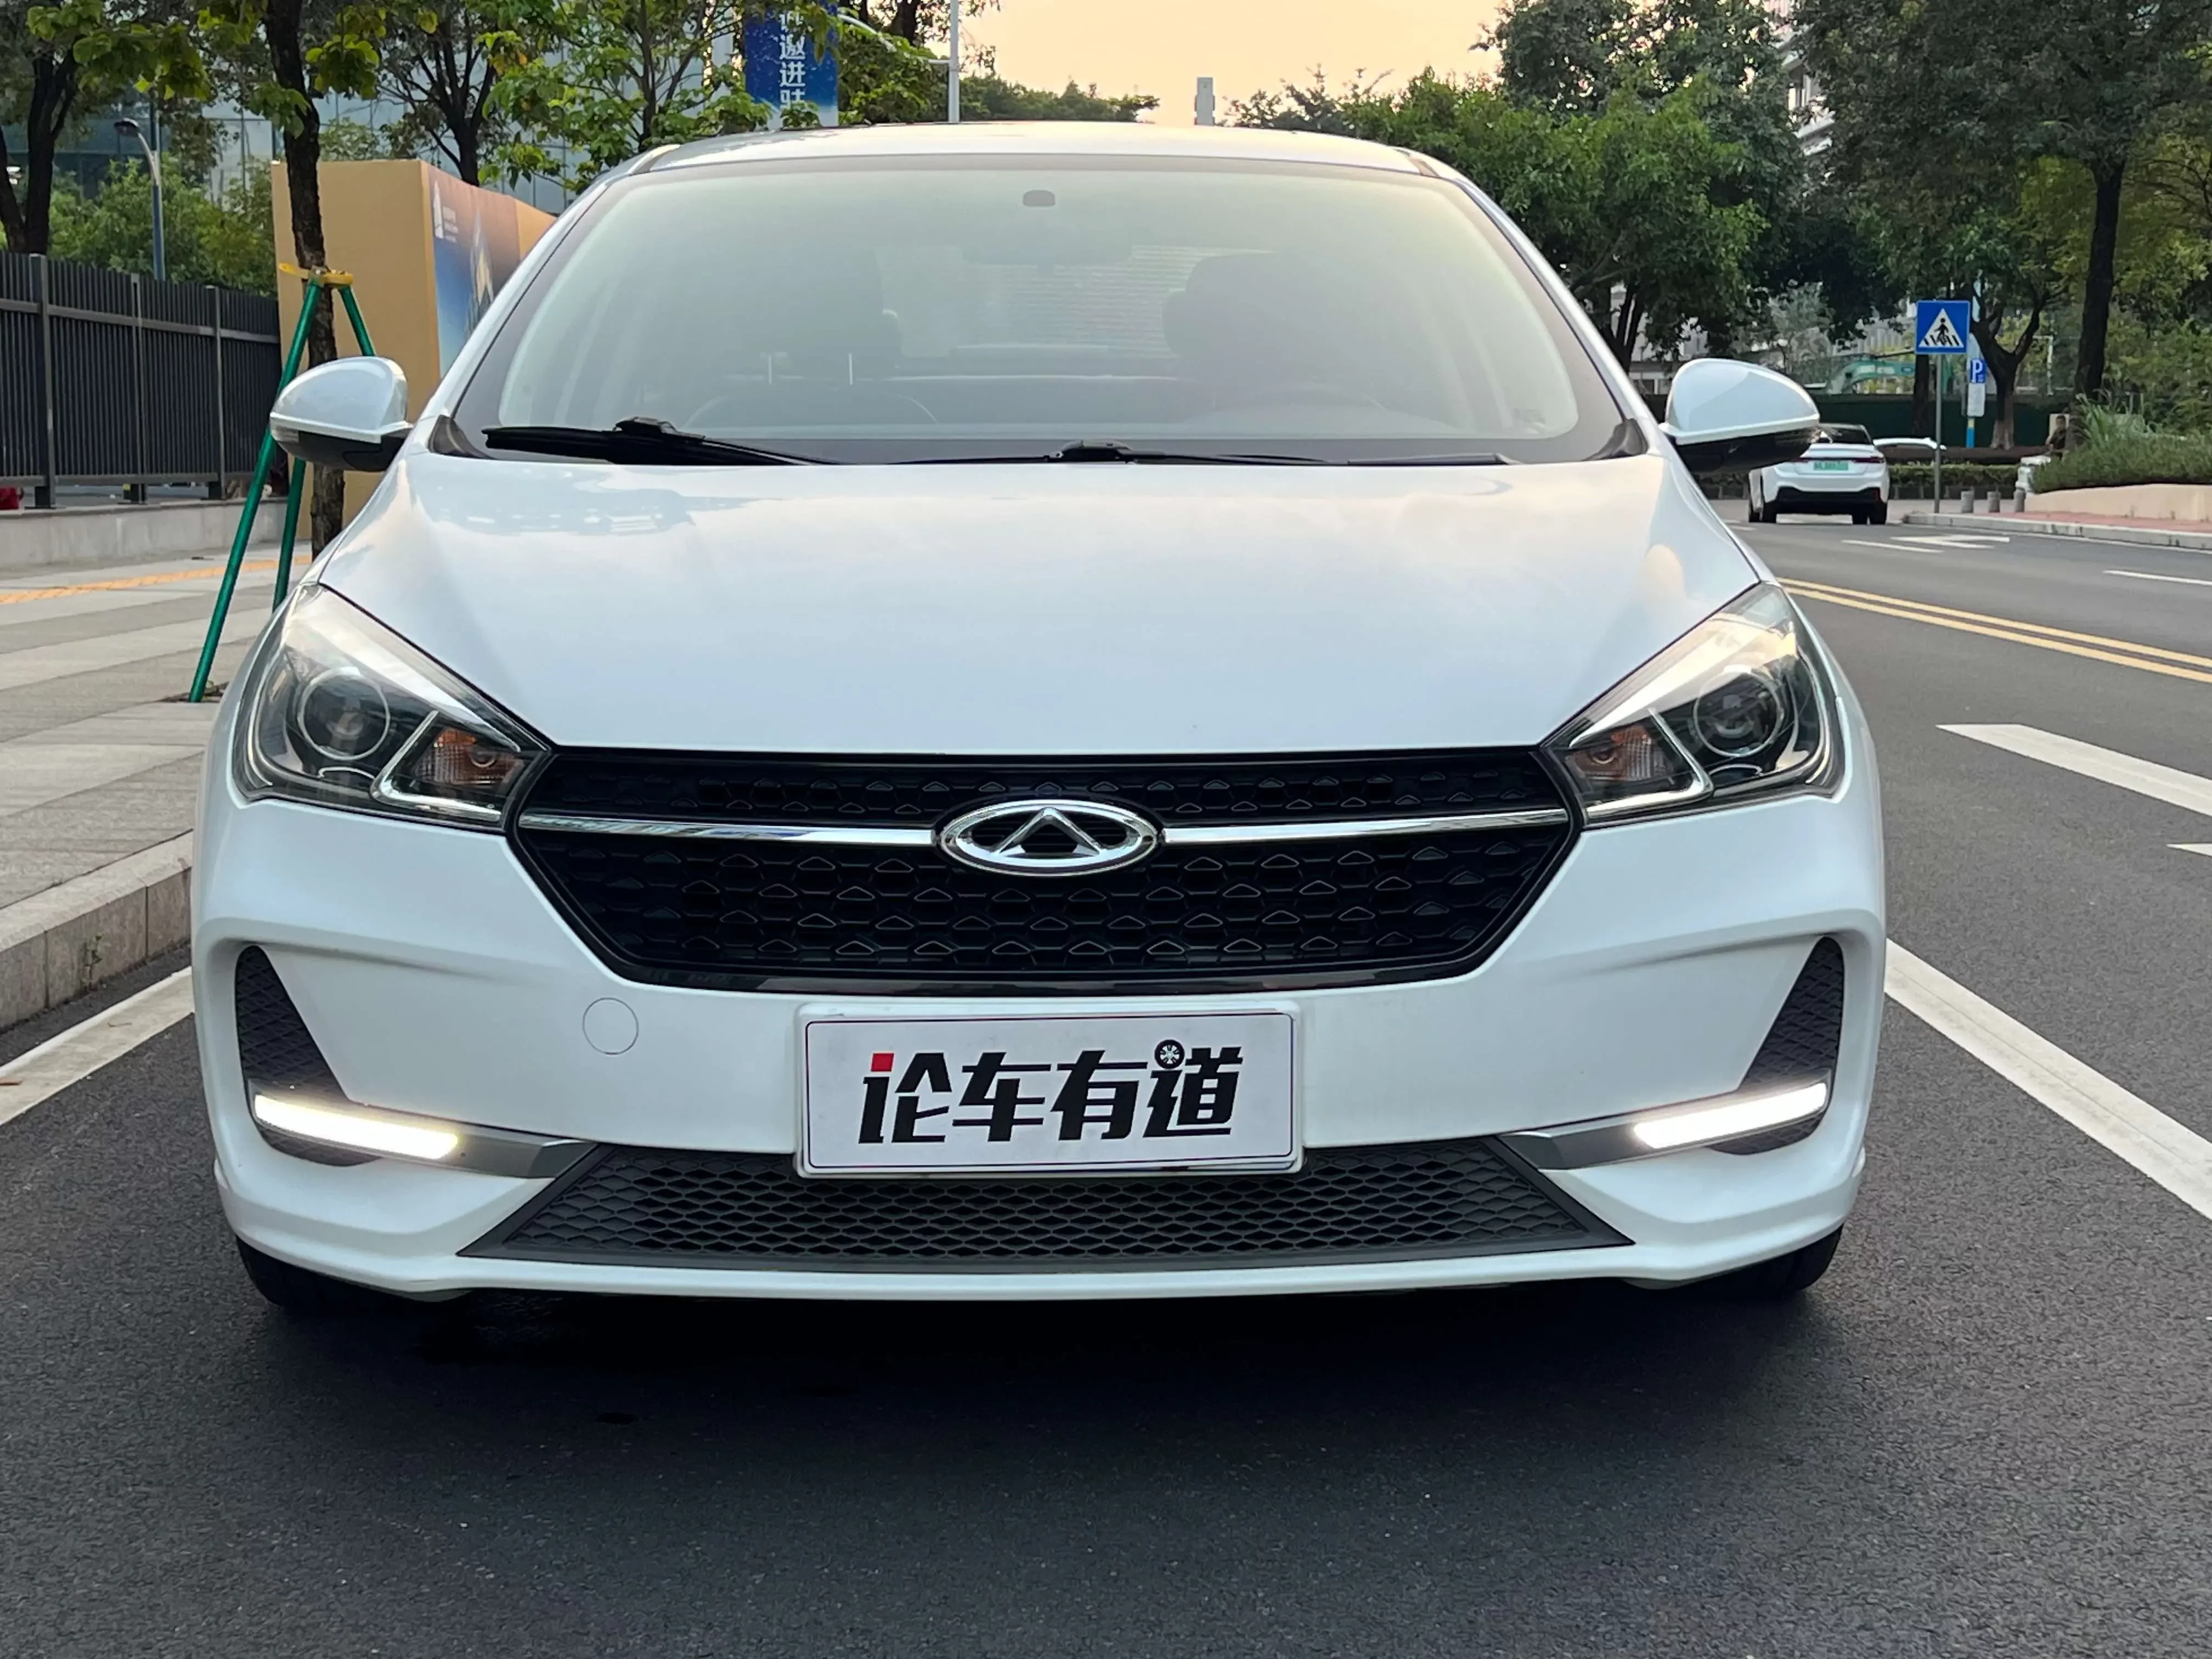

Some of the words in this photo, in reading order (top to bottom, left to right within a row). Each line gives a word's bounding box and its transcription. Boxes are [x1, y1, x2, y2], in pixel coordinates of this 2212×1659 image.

[1972, 359, 1983, 383] P
[859, 1039, 1243, 1144] 论车有道
